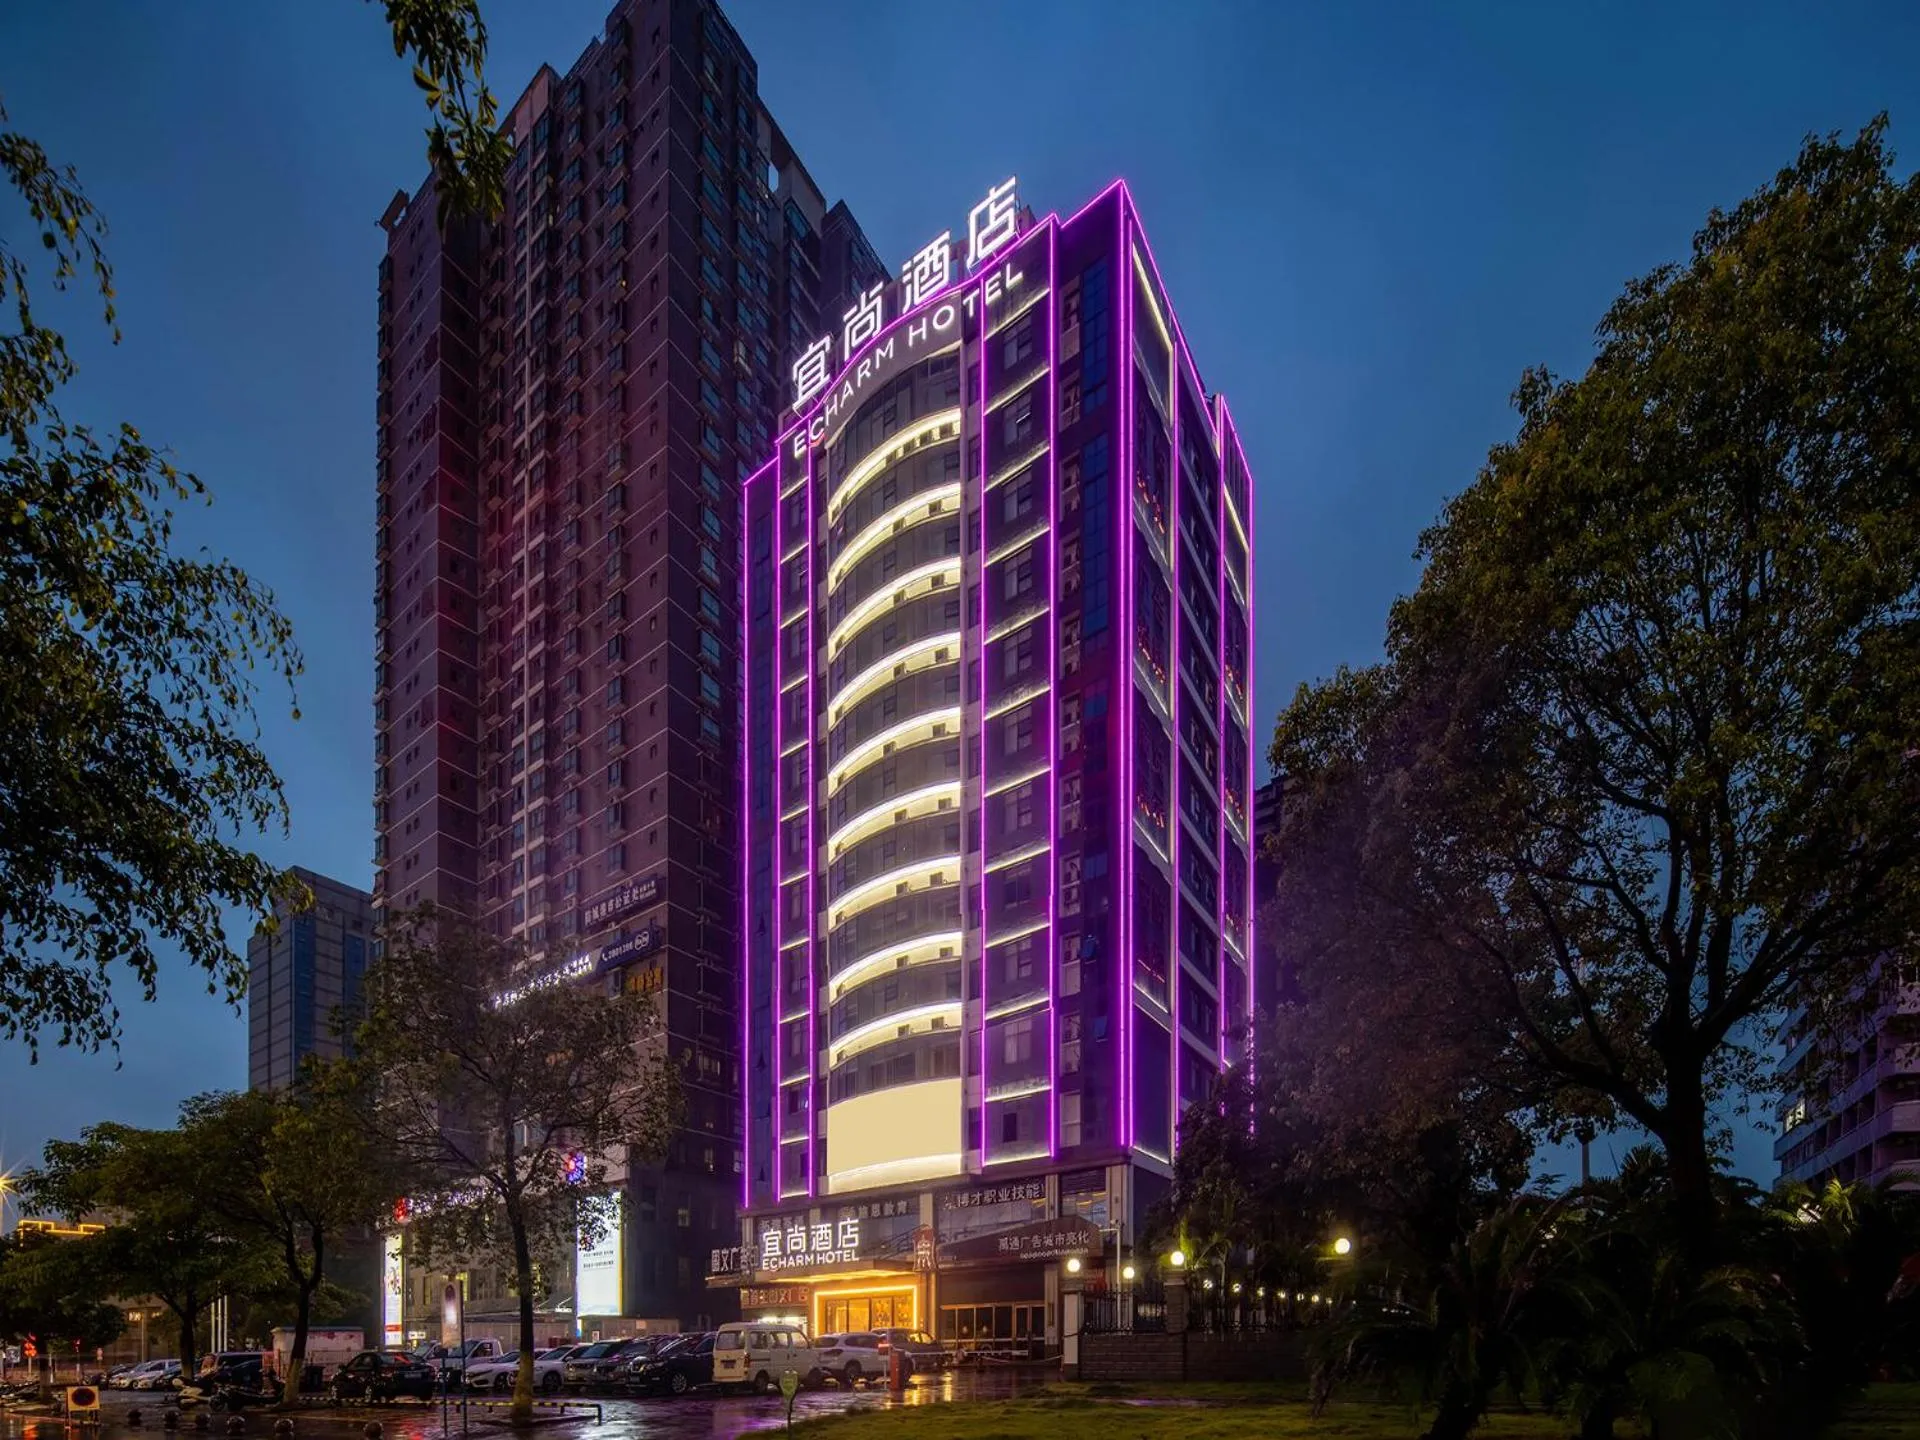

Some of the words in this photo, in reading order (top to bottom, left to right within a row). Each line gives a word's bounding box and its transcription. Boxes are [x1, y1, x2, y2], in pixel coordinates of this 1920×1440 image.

[791, 175, 1016, 408] 宜尚酒店
[793, 337, 894, 458] ECHARM
[908, 263, 1023, 348] HOTEL
[762, 1217, 859, 1257] 宜尚酒店
[762, 1254, 815, 1271] ECHARM
[817, 1249, 860, 1265] HOTEL
